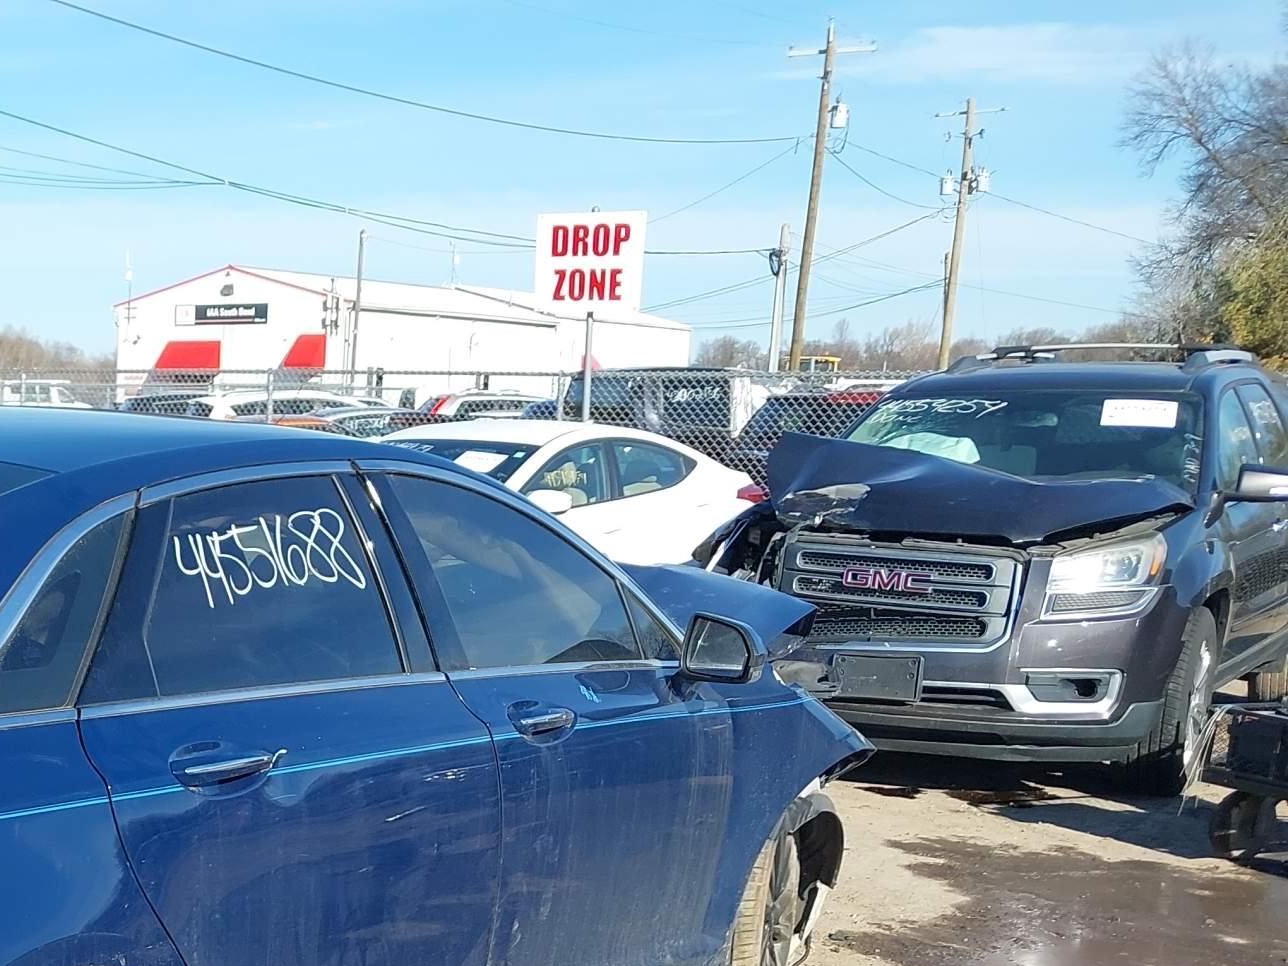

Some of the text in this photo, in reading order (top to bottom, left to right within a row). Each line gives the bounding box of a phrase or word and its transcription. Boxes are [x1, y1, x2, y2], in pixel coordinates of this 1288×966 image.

[551, 223, 631, 257] DROP
[552, 268, 623, 301] ZONE
[173, 508, 367, 609] 44551688
[843, 565, 934, 594] GMC
